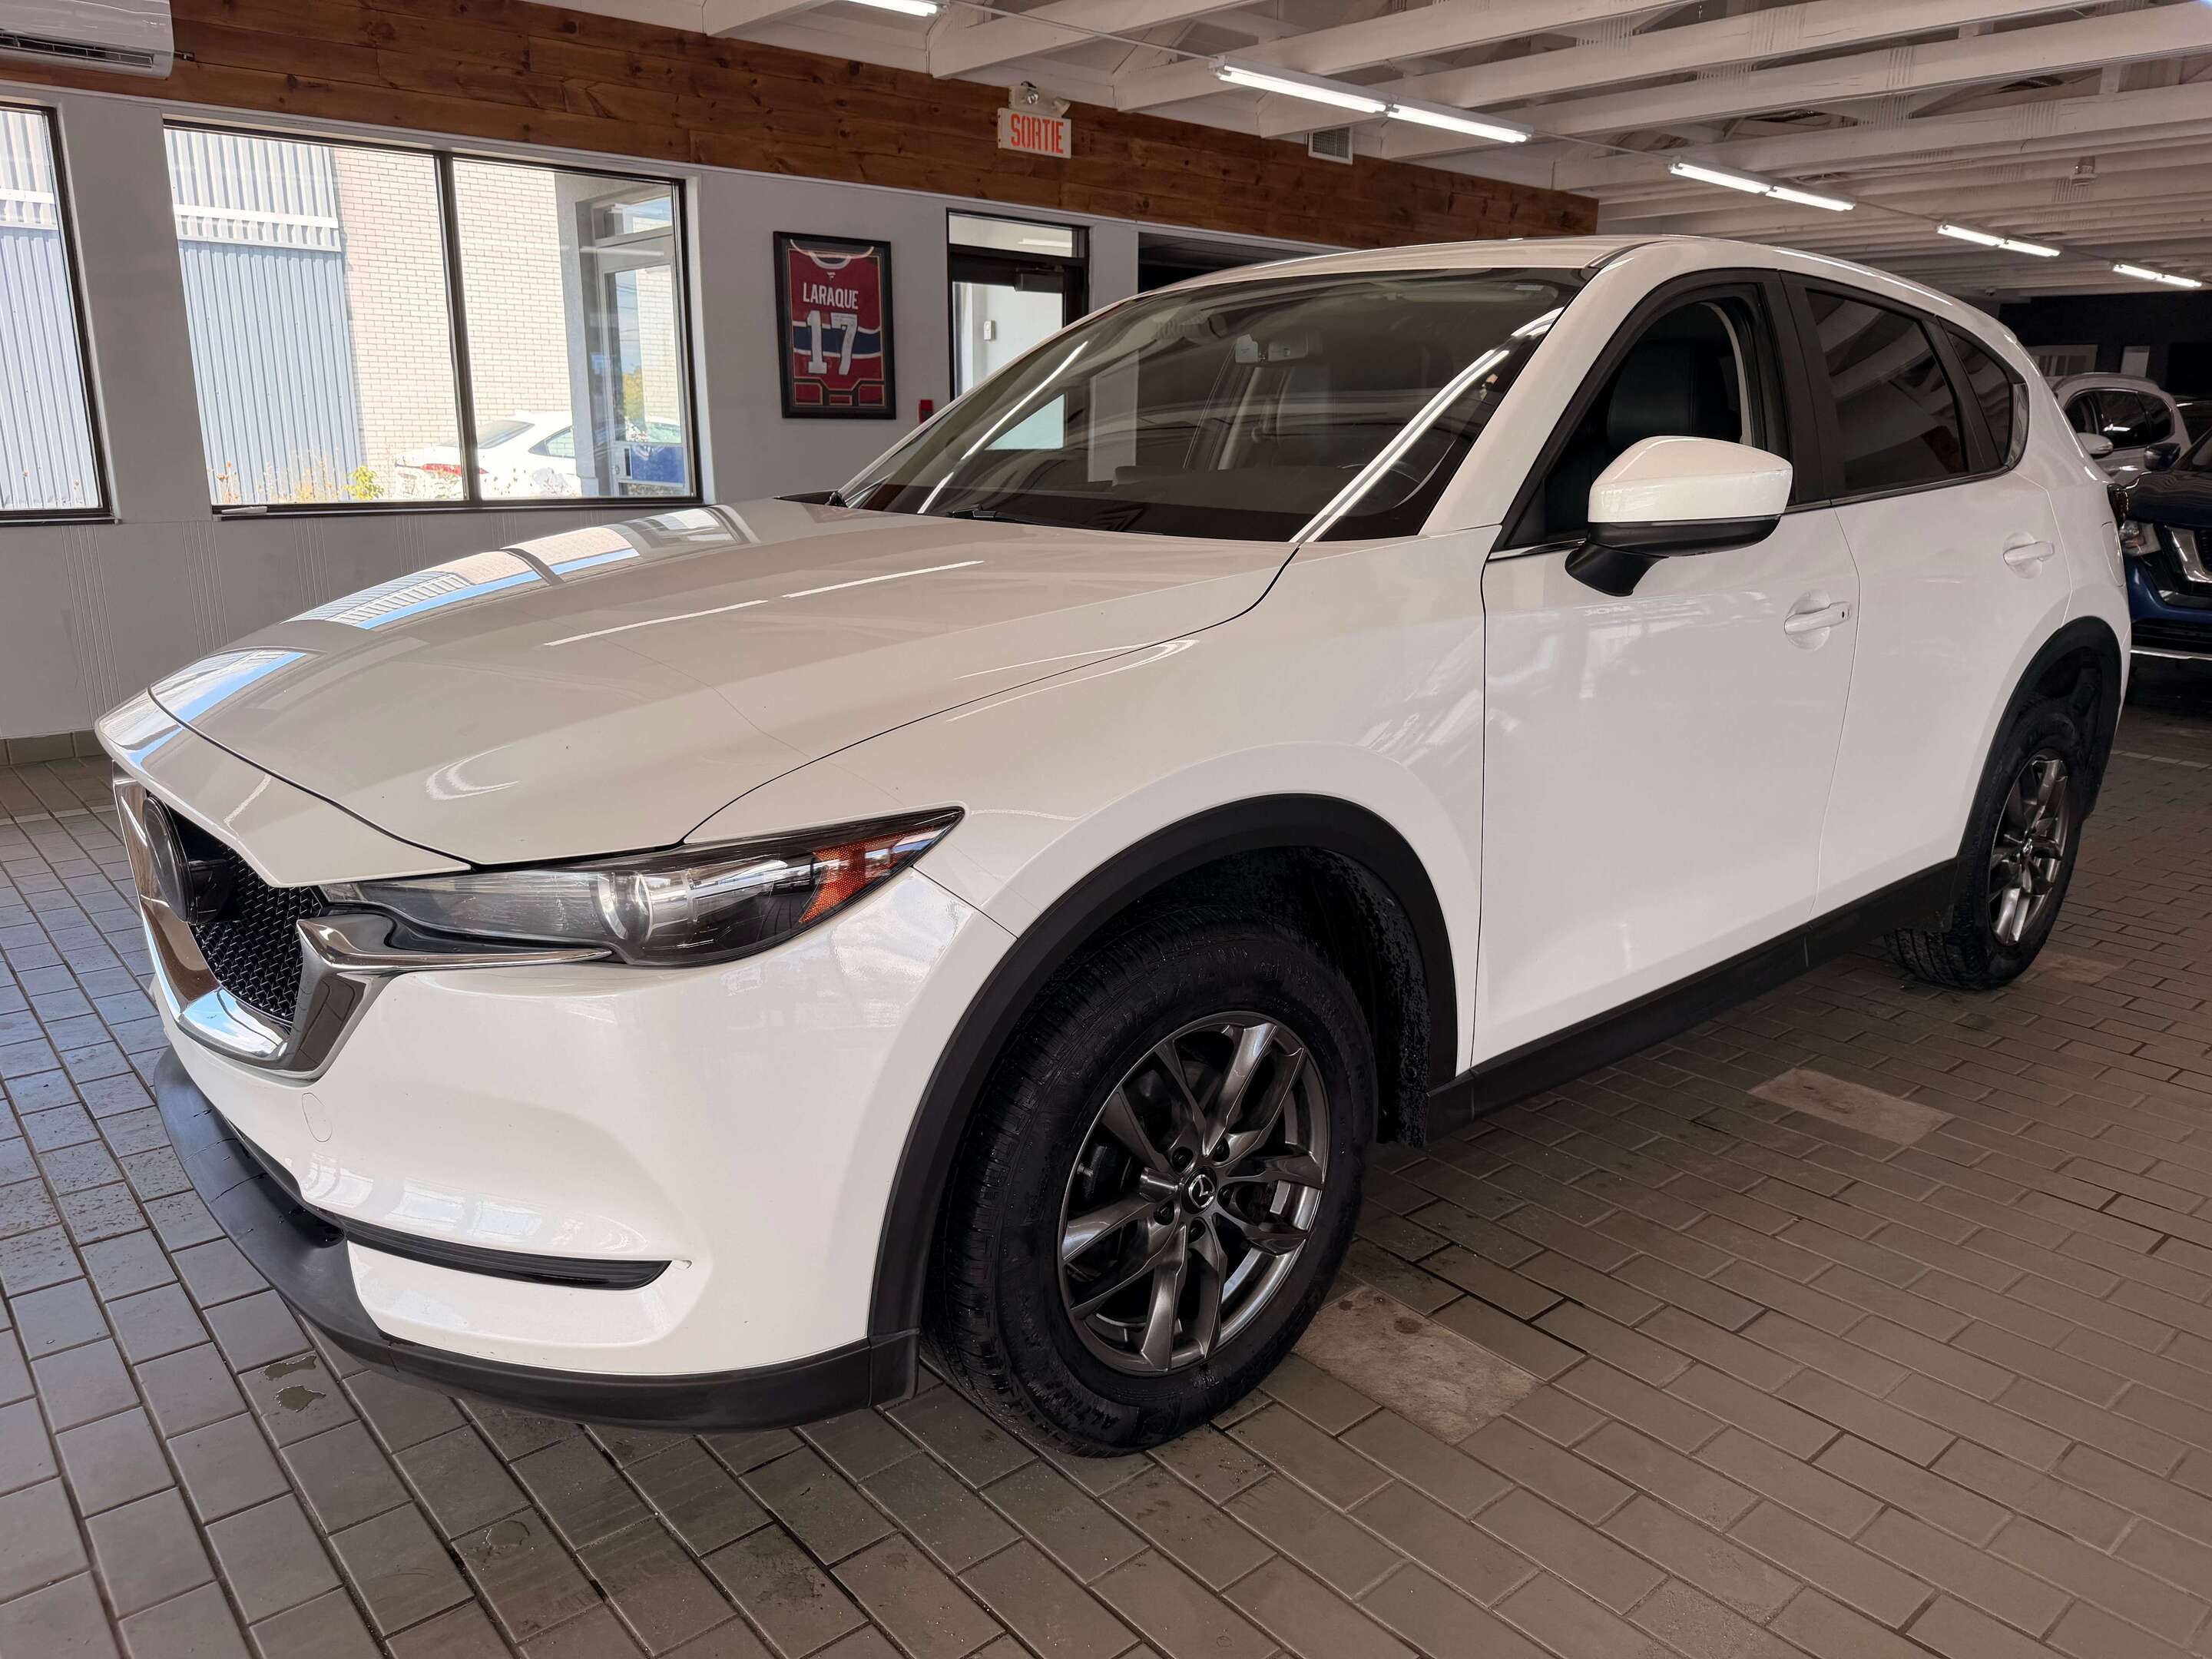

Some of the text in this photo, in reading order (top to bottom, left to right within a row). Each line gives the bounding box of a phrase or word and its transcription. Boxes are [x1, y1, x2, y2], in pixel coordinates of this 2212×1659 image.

[1010, 113, 1064, 154] SORTIE
[803, 282, 859, 310] LARAQUE
[806, 310, 858, 375] 17
